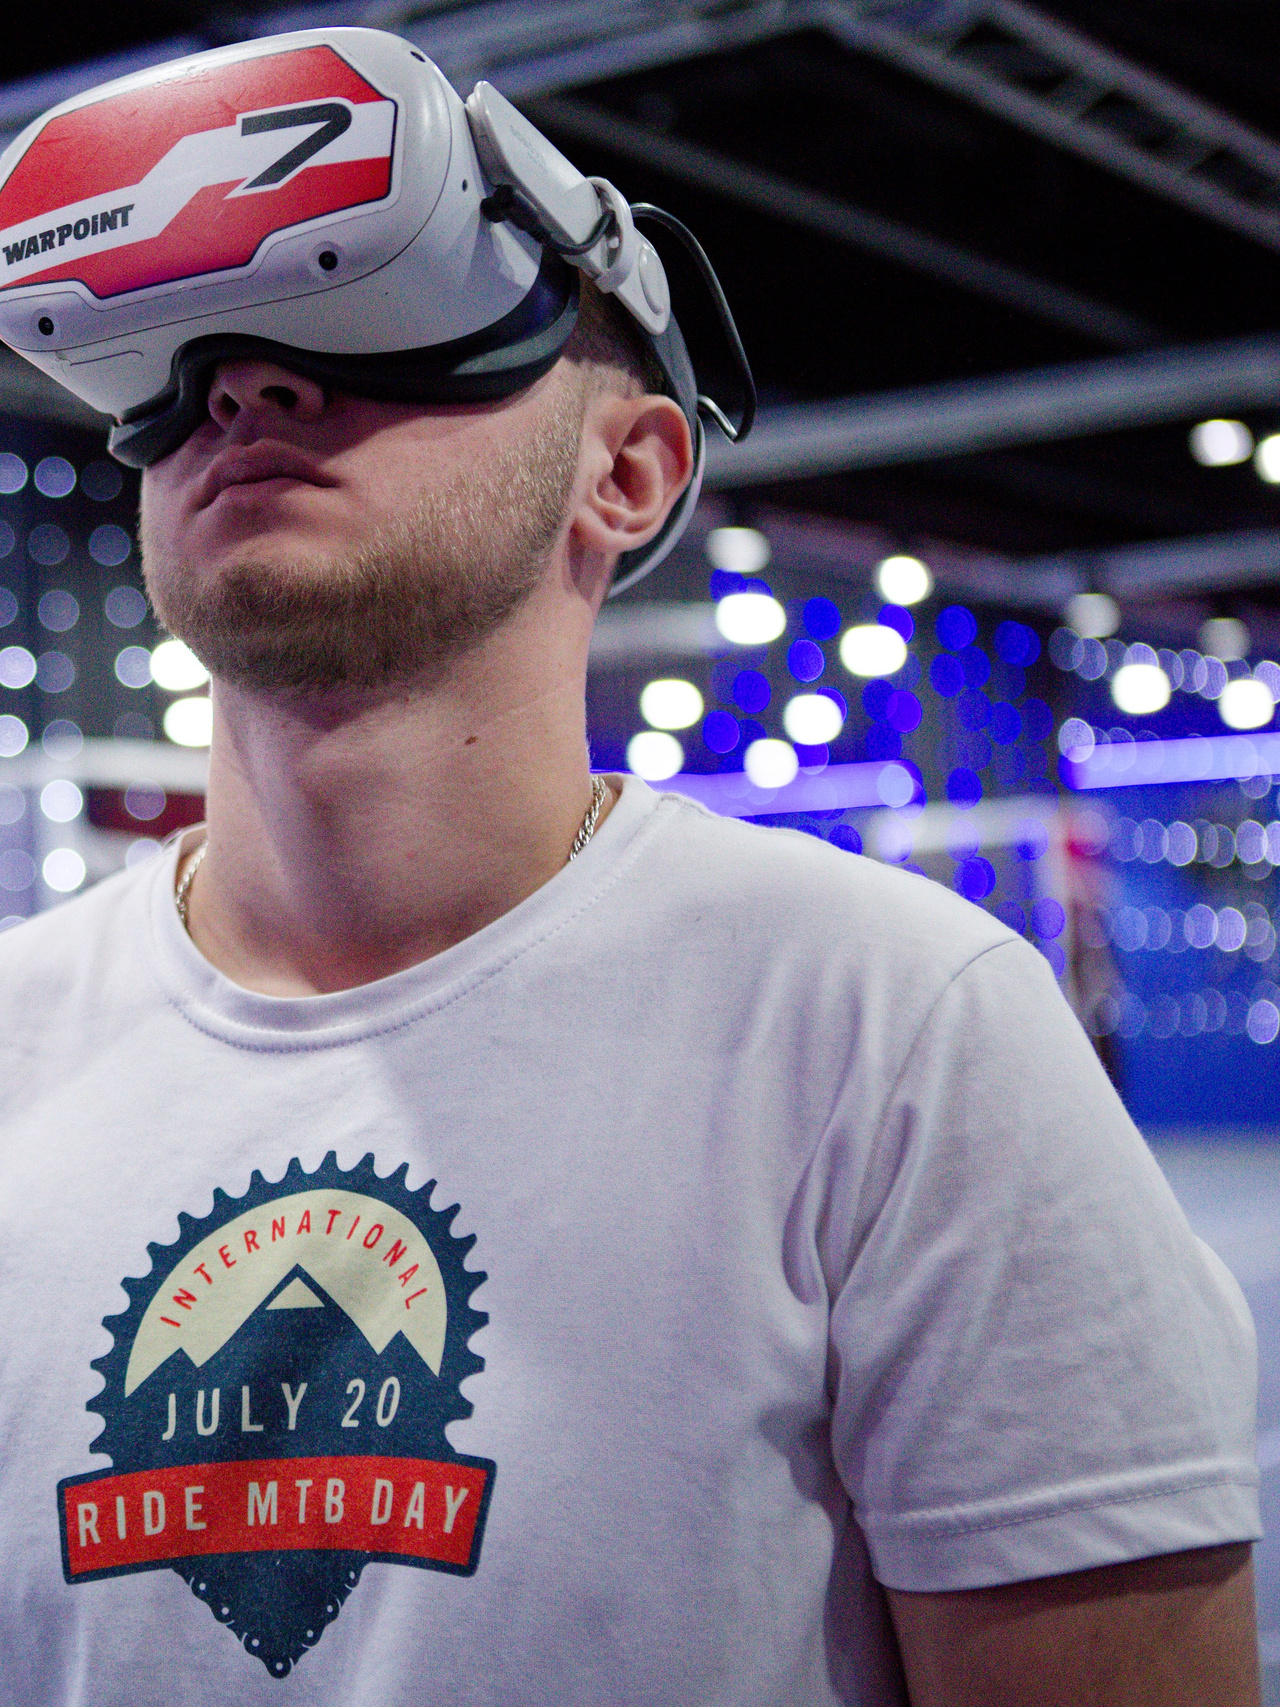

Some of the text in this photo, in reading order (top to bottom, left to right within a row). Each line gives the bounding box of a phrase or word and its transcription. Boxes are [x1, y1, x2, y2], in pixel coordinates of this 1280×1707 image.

[240, 102, 352, 190] 7
[160, 1209, 428, 1328] INTERNATIONAL
[162, 1376, 401, 1440] JULY 20
[77, 1478, 470, 1547] RIDE MTB DAY
